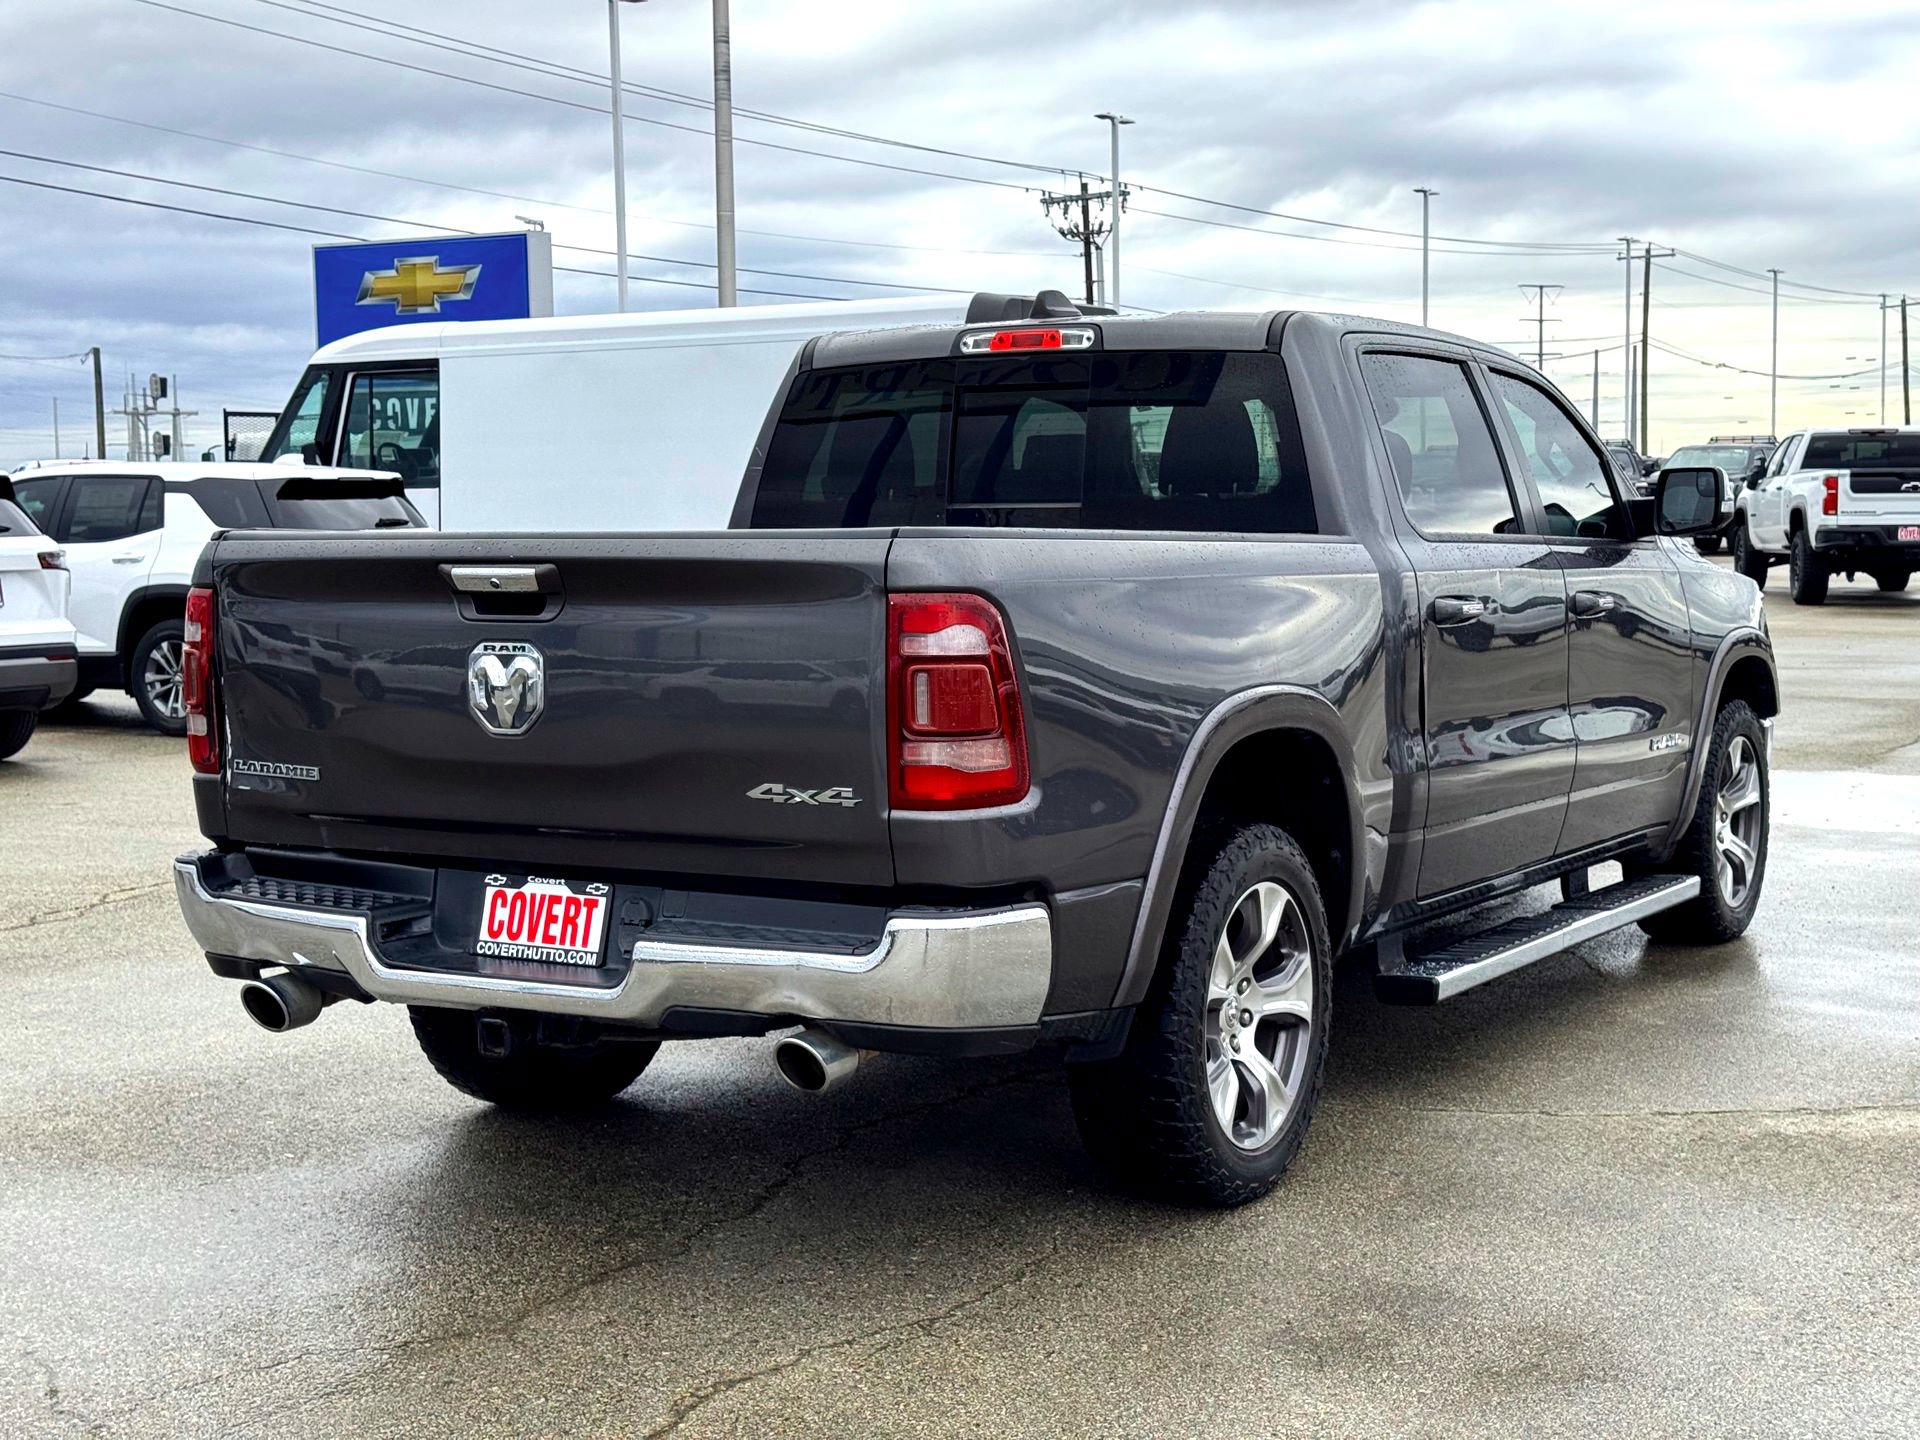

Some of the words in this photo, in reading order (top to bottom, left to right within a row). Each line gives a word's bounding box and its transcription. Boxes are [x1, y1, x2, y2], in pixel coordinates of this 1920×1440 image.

[483, 644, 526, 653] RAM
[234, 759, 320, 781] LARAMIE
[527, 875, 566, 885] Covert
[487, 889, 600, 949] COVERT
[476, 941, 598, 966] COVERTHUTTO.COM
